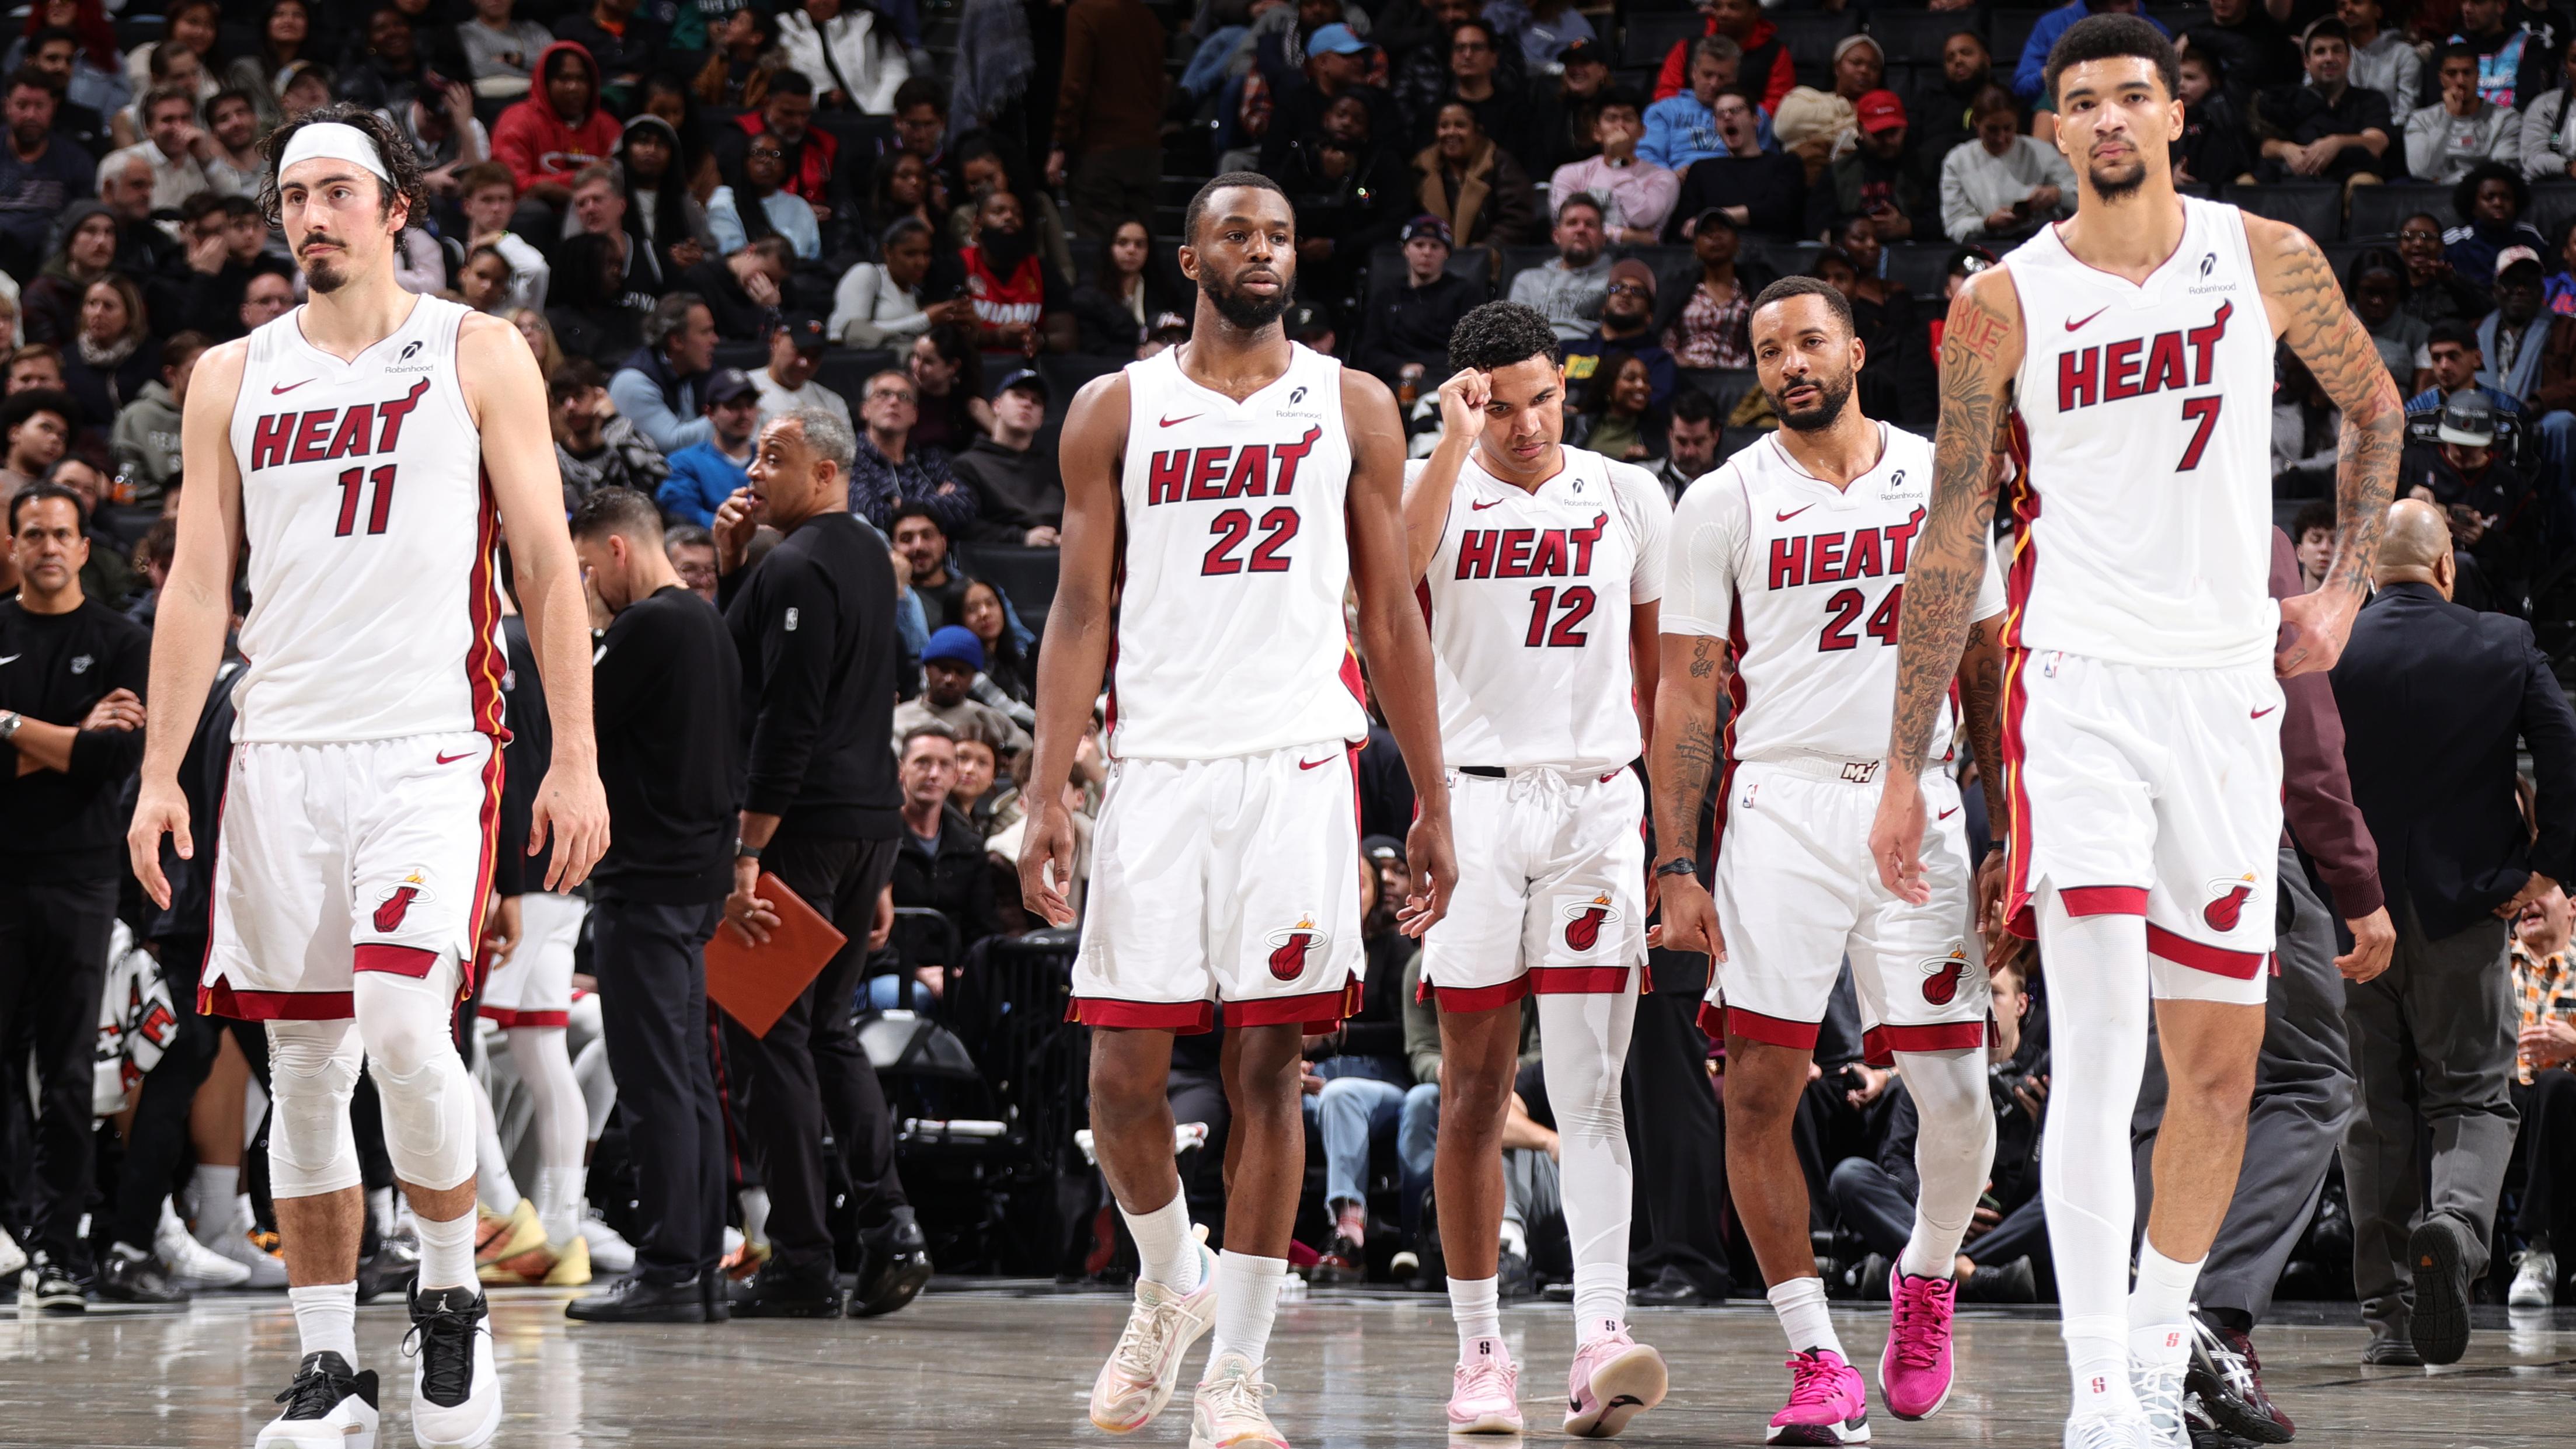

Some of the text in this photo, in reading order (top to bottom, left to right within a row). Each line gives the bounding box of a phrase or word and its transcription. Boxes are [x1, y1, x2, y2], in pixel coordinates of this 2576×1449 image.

[2189, 282, 2236, 294] Robinhood
[972, 298, 1043, 324] MIAMI
[385, 364, 434, 374] Robinhood
[2058, 300, 2232, 413] HEAT
[252, 377, 430, 472] HEAT
[1276, 410, 1322, 419] Robinhood
[2176, 395, 2222, 472] 7
[1148, 425, 1321, 506] HEAT
[335, 464, 397, 537] 11
[1881, 492, 1923, 500] Robinhood
[1201, 507, 1300, 576] 22
[1455, 511, 1608, 580] HEAT
[1769, 503, 1926, 591] HEAT
[1525, 586, 1597, 647] 12
[1818, 584, 1904, 653] 24
[1841, 760, 1879, 783] MH
[1606, 1320, 1615, 1331] S
[2166, 1333, 2180, 1347] S
[1480, 1342, 1490, 1354] S
[2092, 1377, 2106, 1394] S
